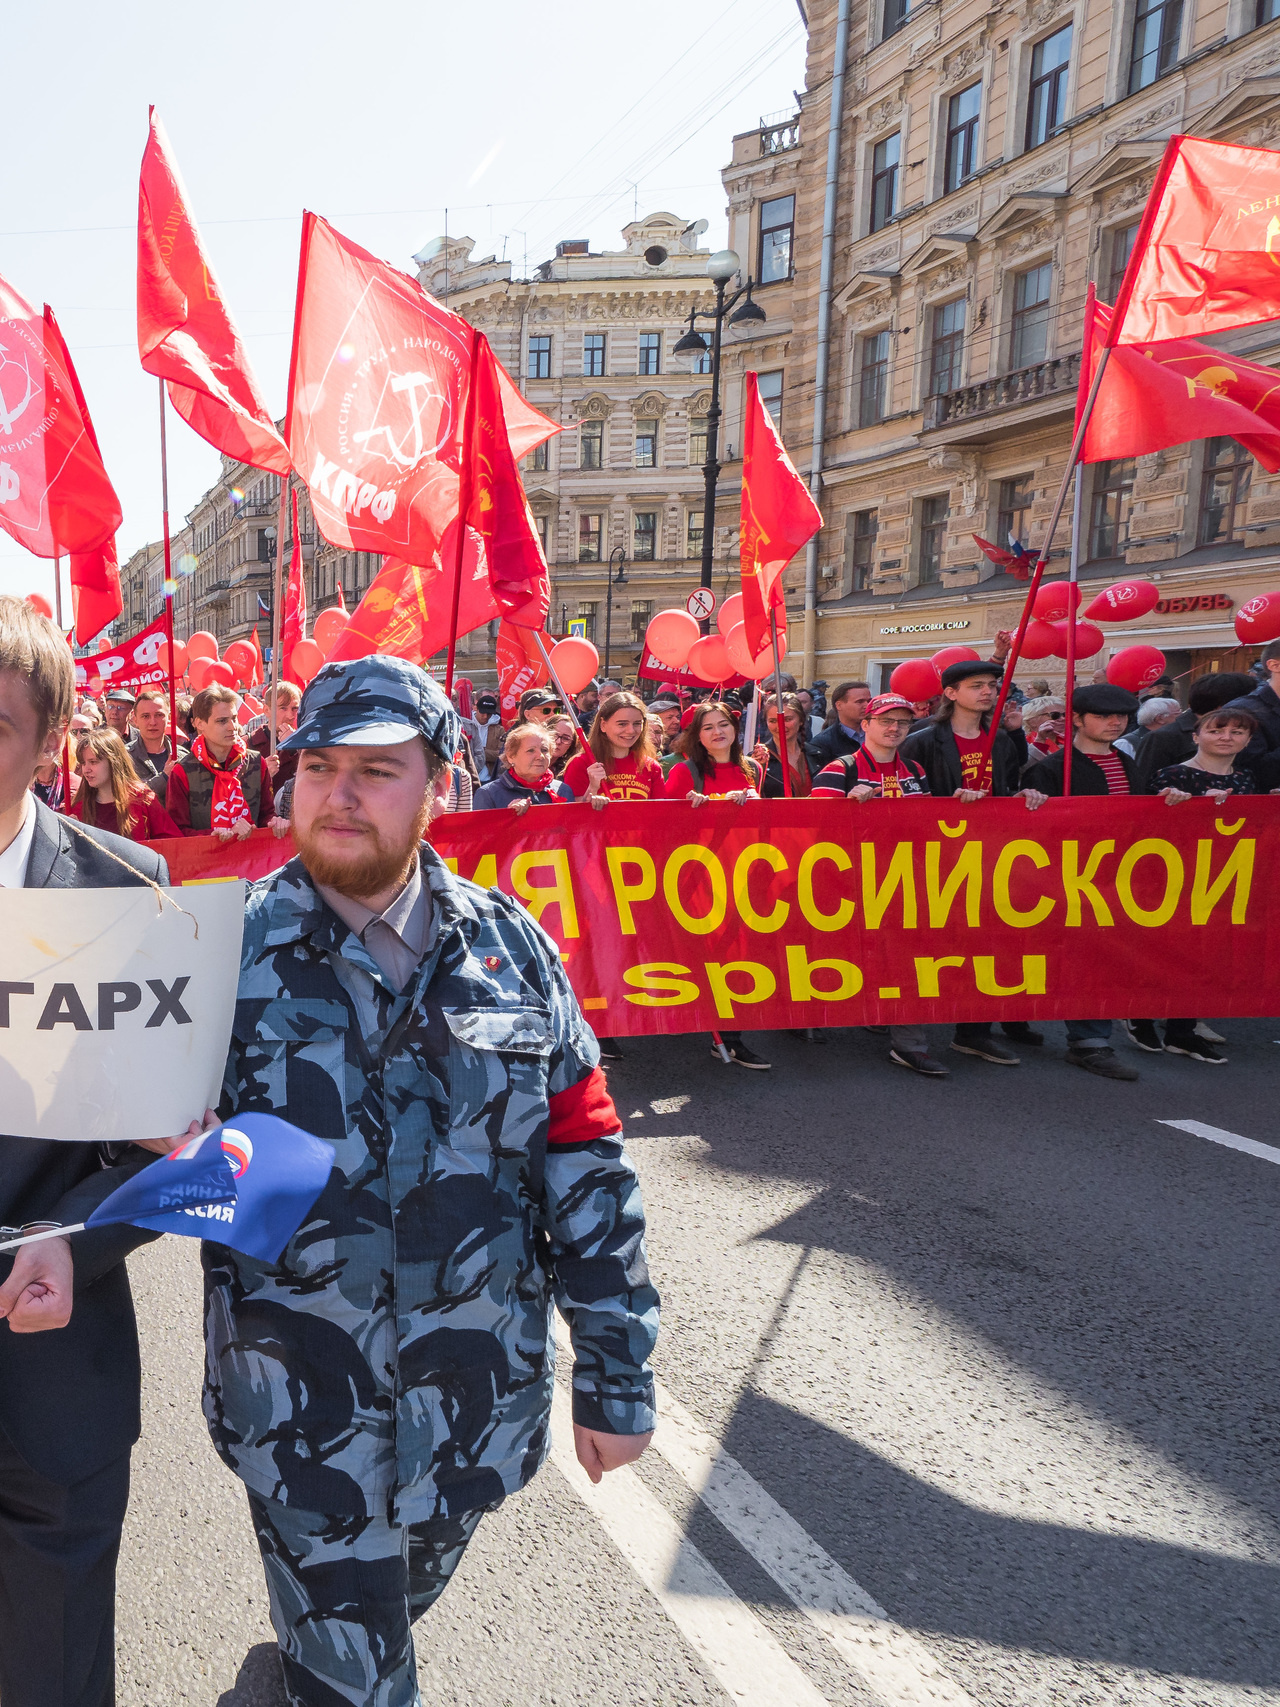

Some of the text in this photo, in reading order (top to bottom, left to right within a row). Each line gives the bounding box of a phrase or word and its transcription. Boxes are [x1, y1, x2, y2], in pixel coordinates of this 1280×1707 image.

[338, 392, 354, 455] РОССИЯ
[355, 347, 389, 379] ТРУД
[309, 451, 397, 524] КПРФ
[946, 620, 970, 630] СИДР
[1154, 593, 1233, 614] ОБУВЬ
[605, 816, 1257, 937] РОССИЙСКОЙ
